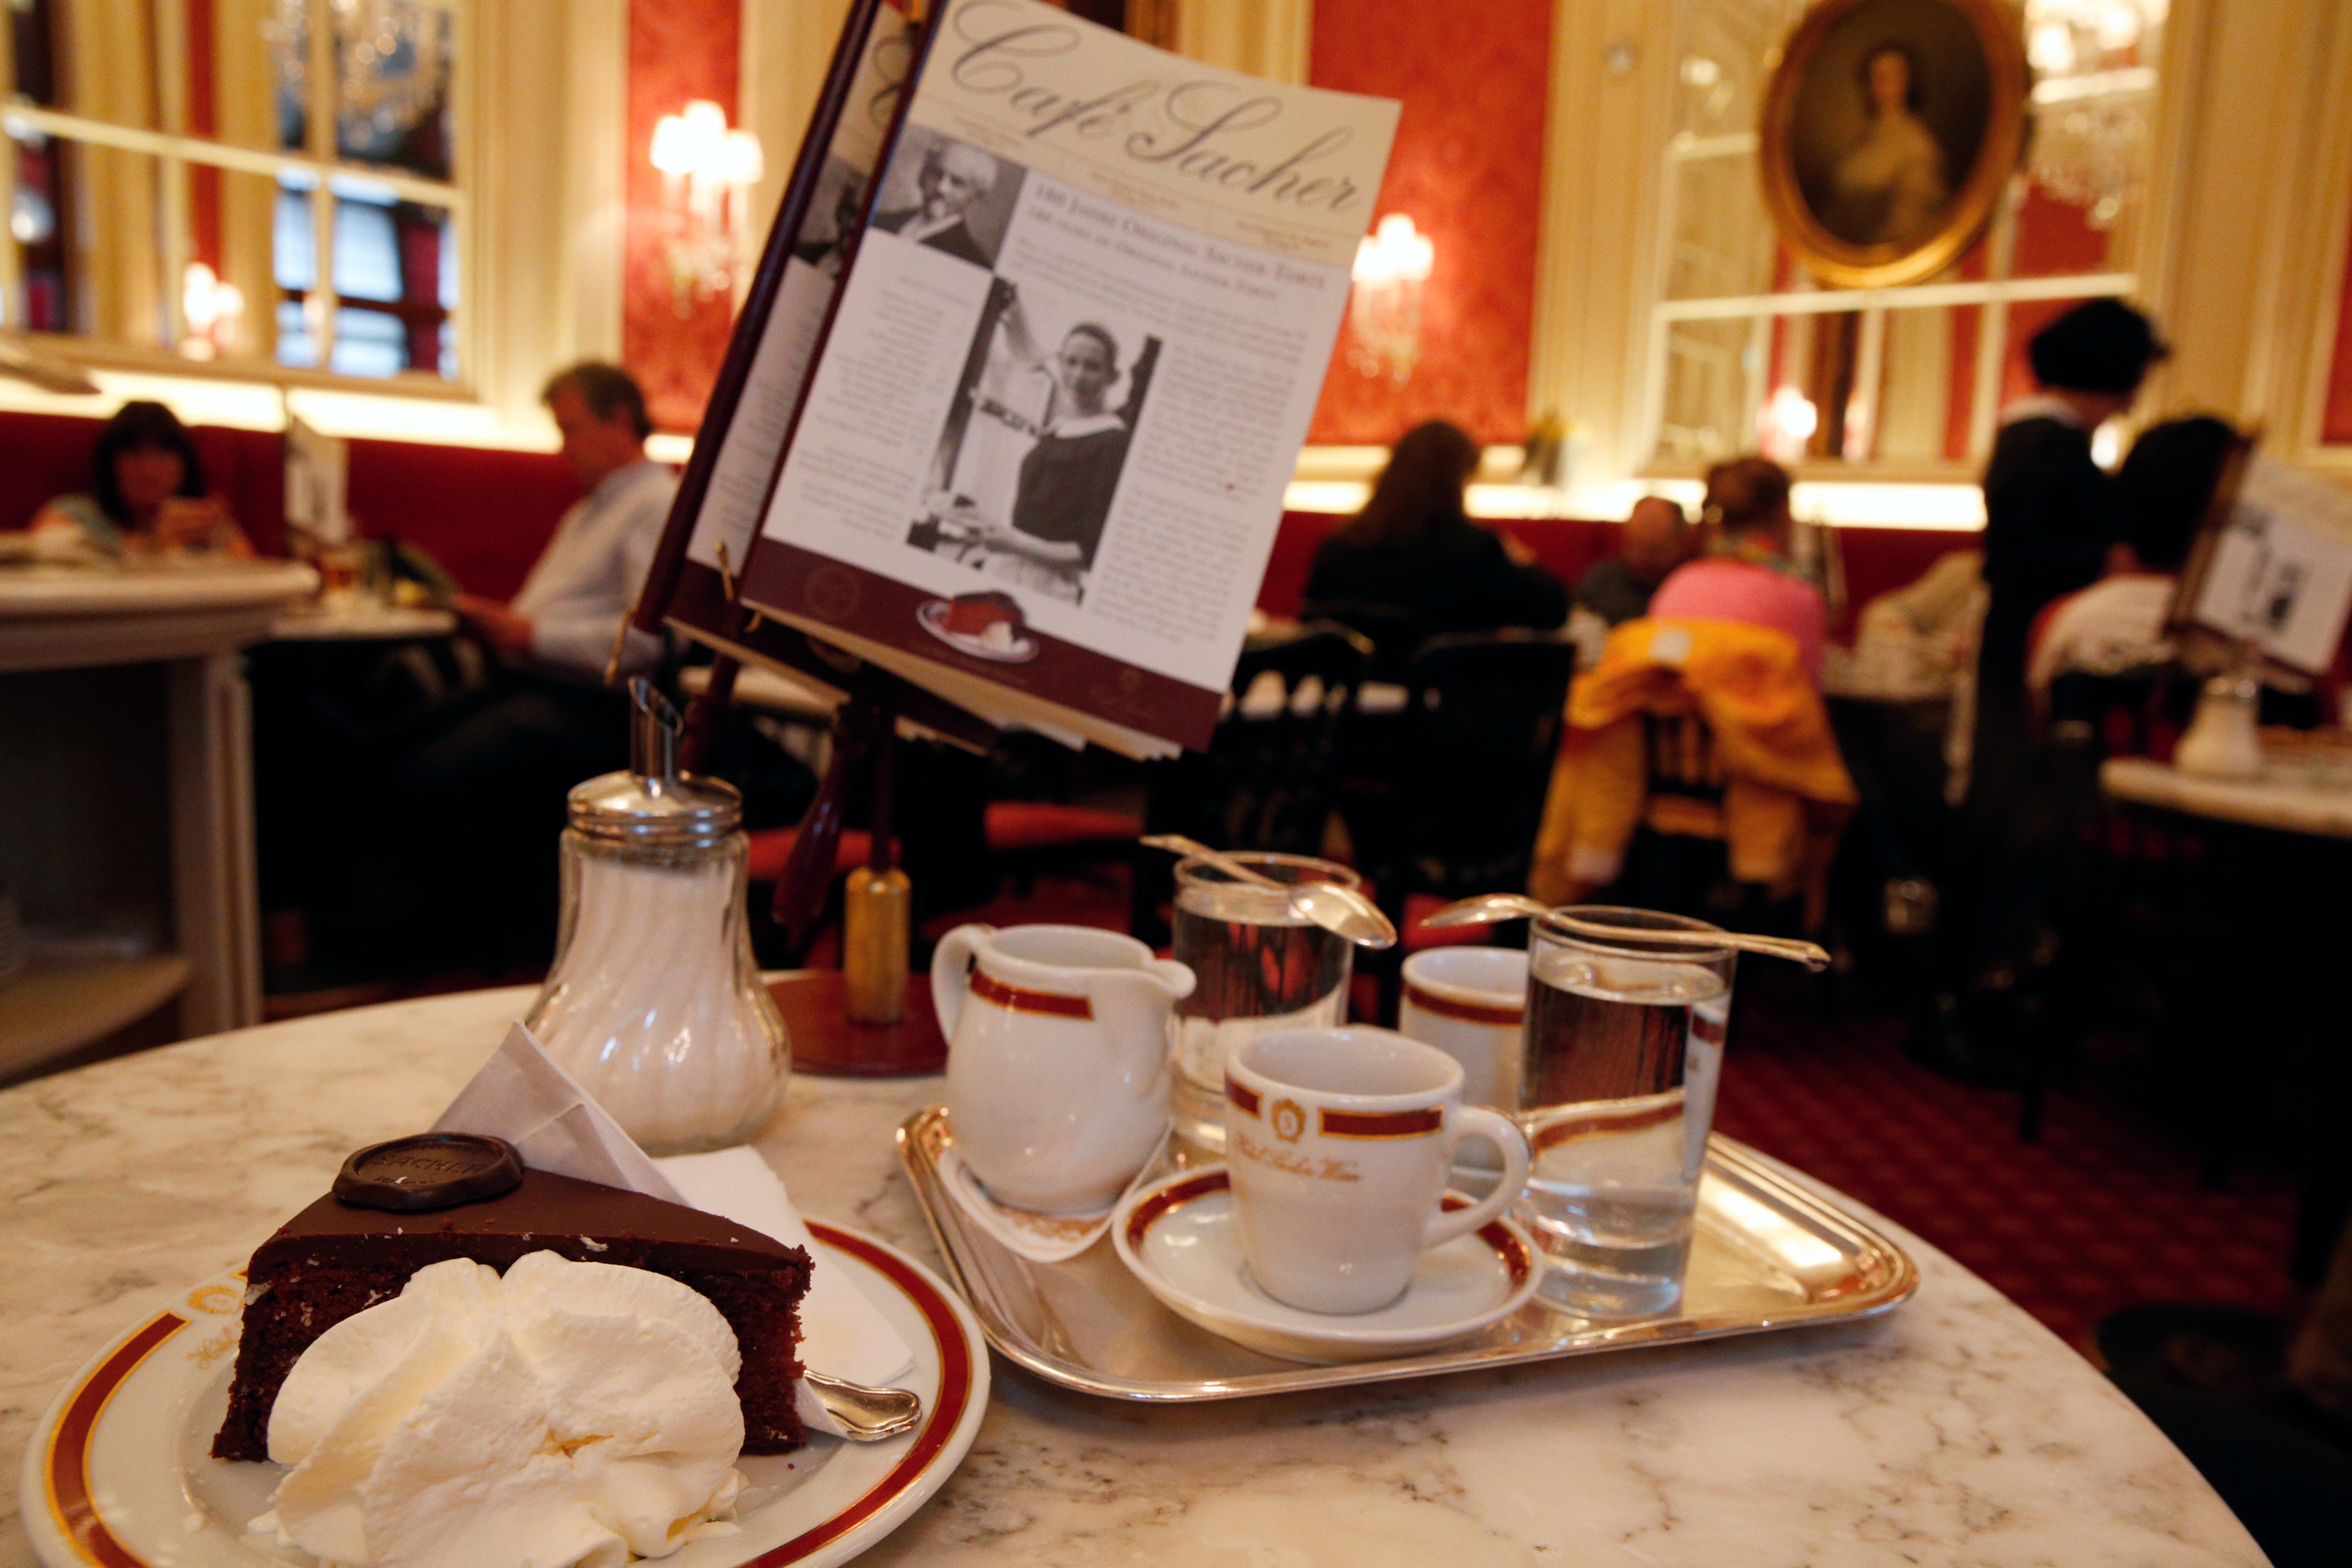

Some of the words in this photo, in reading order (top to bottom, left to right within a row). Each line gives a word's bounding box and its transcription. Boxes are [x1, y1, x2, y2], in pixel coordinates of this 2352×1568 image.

[952, 0, 1159, 139] Café
[1125, 80, 1361, 210] Sacher
[370, 1154, 488, 1174] SACHER
